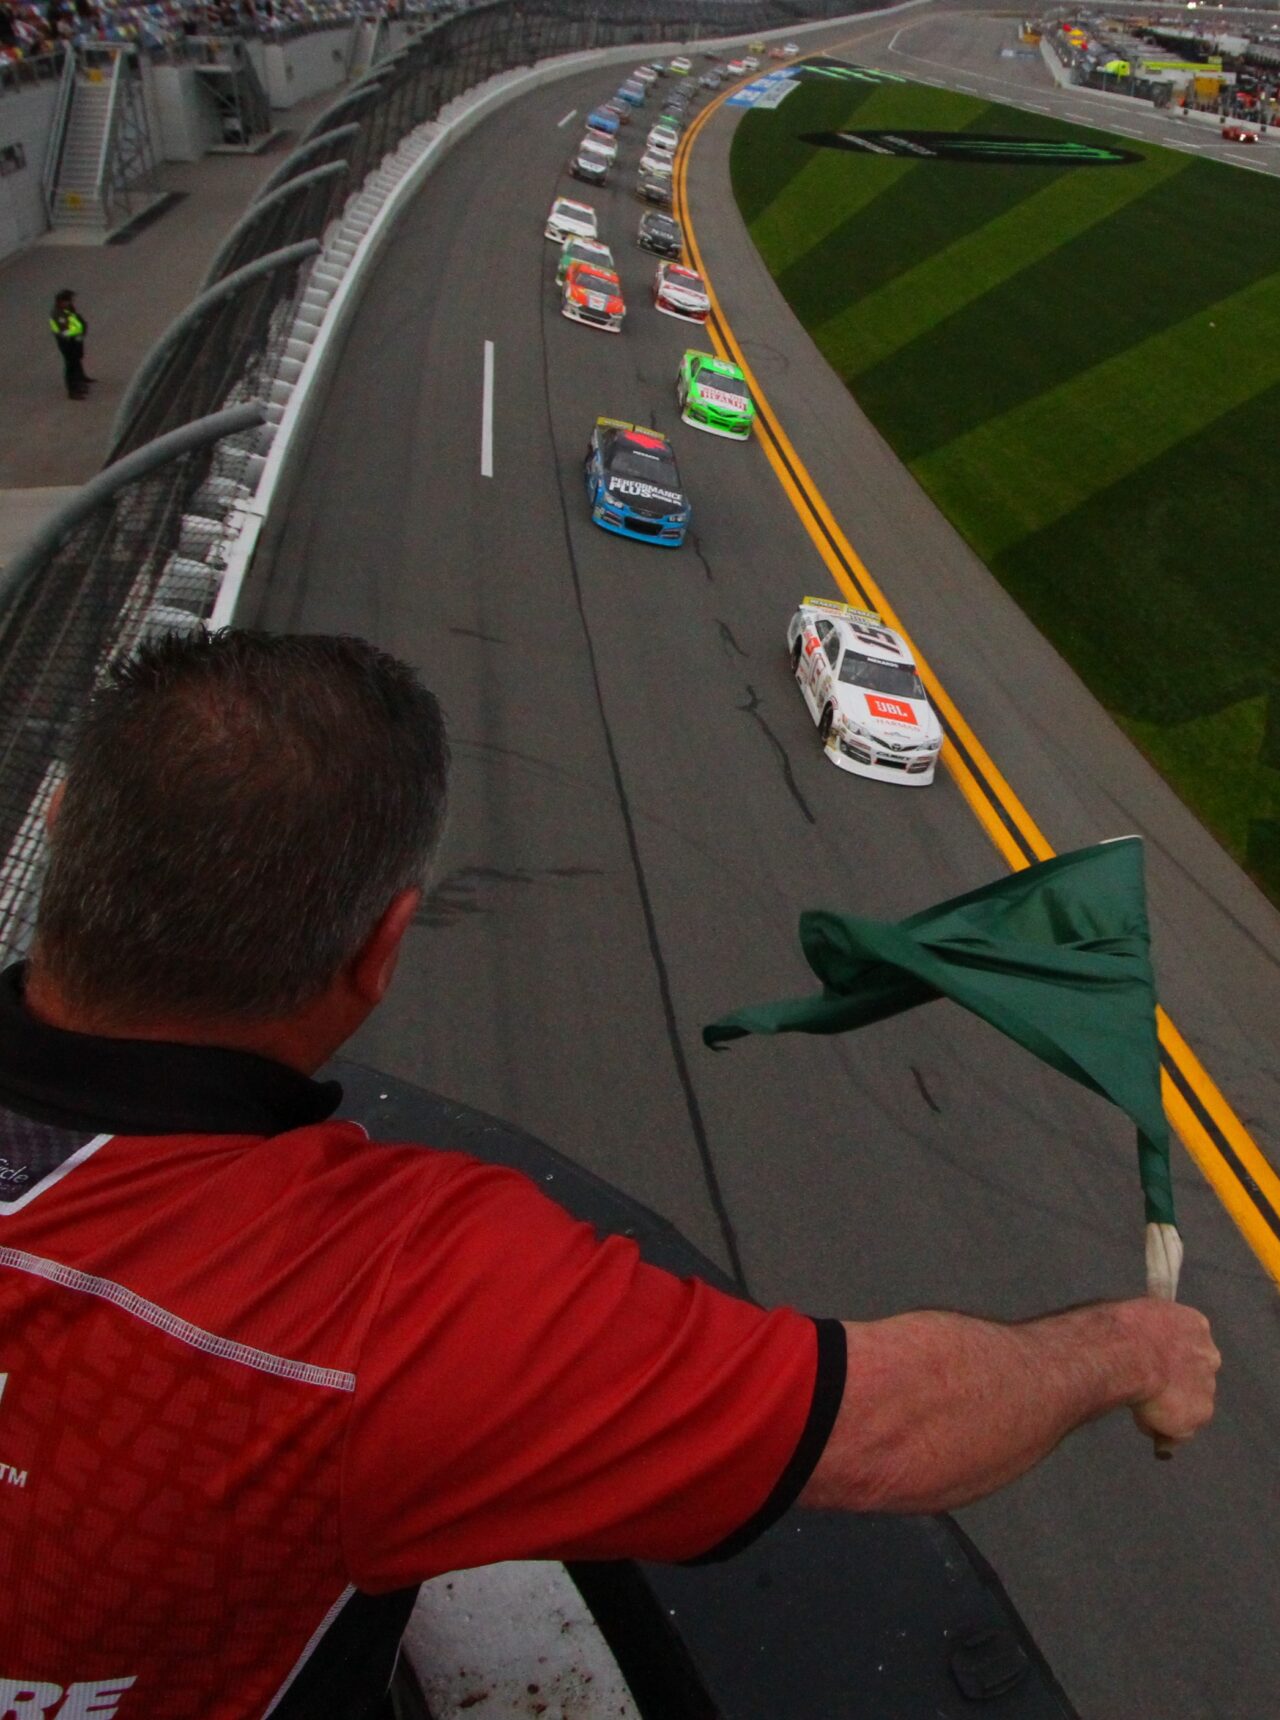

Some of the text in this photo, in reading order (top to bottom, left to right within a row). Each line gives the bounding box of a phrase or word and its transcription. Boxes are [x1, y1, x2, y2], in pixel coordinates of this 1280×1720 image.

[609, 482, 652, 499] PLUS
[611, 476, 683, 501] PERFORMANCE
[875, 700, 909, 717] JBL
